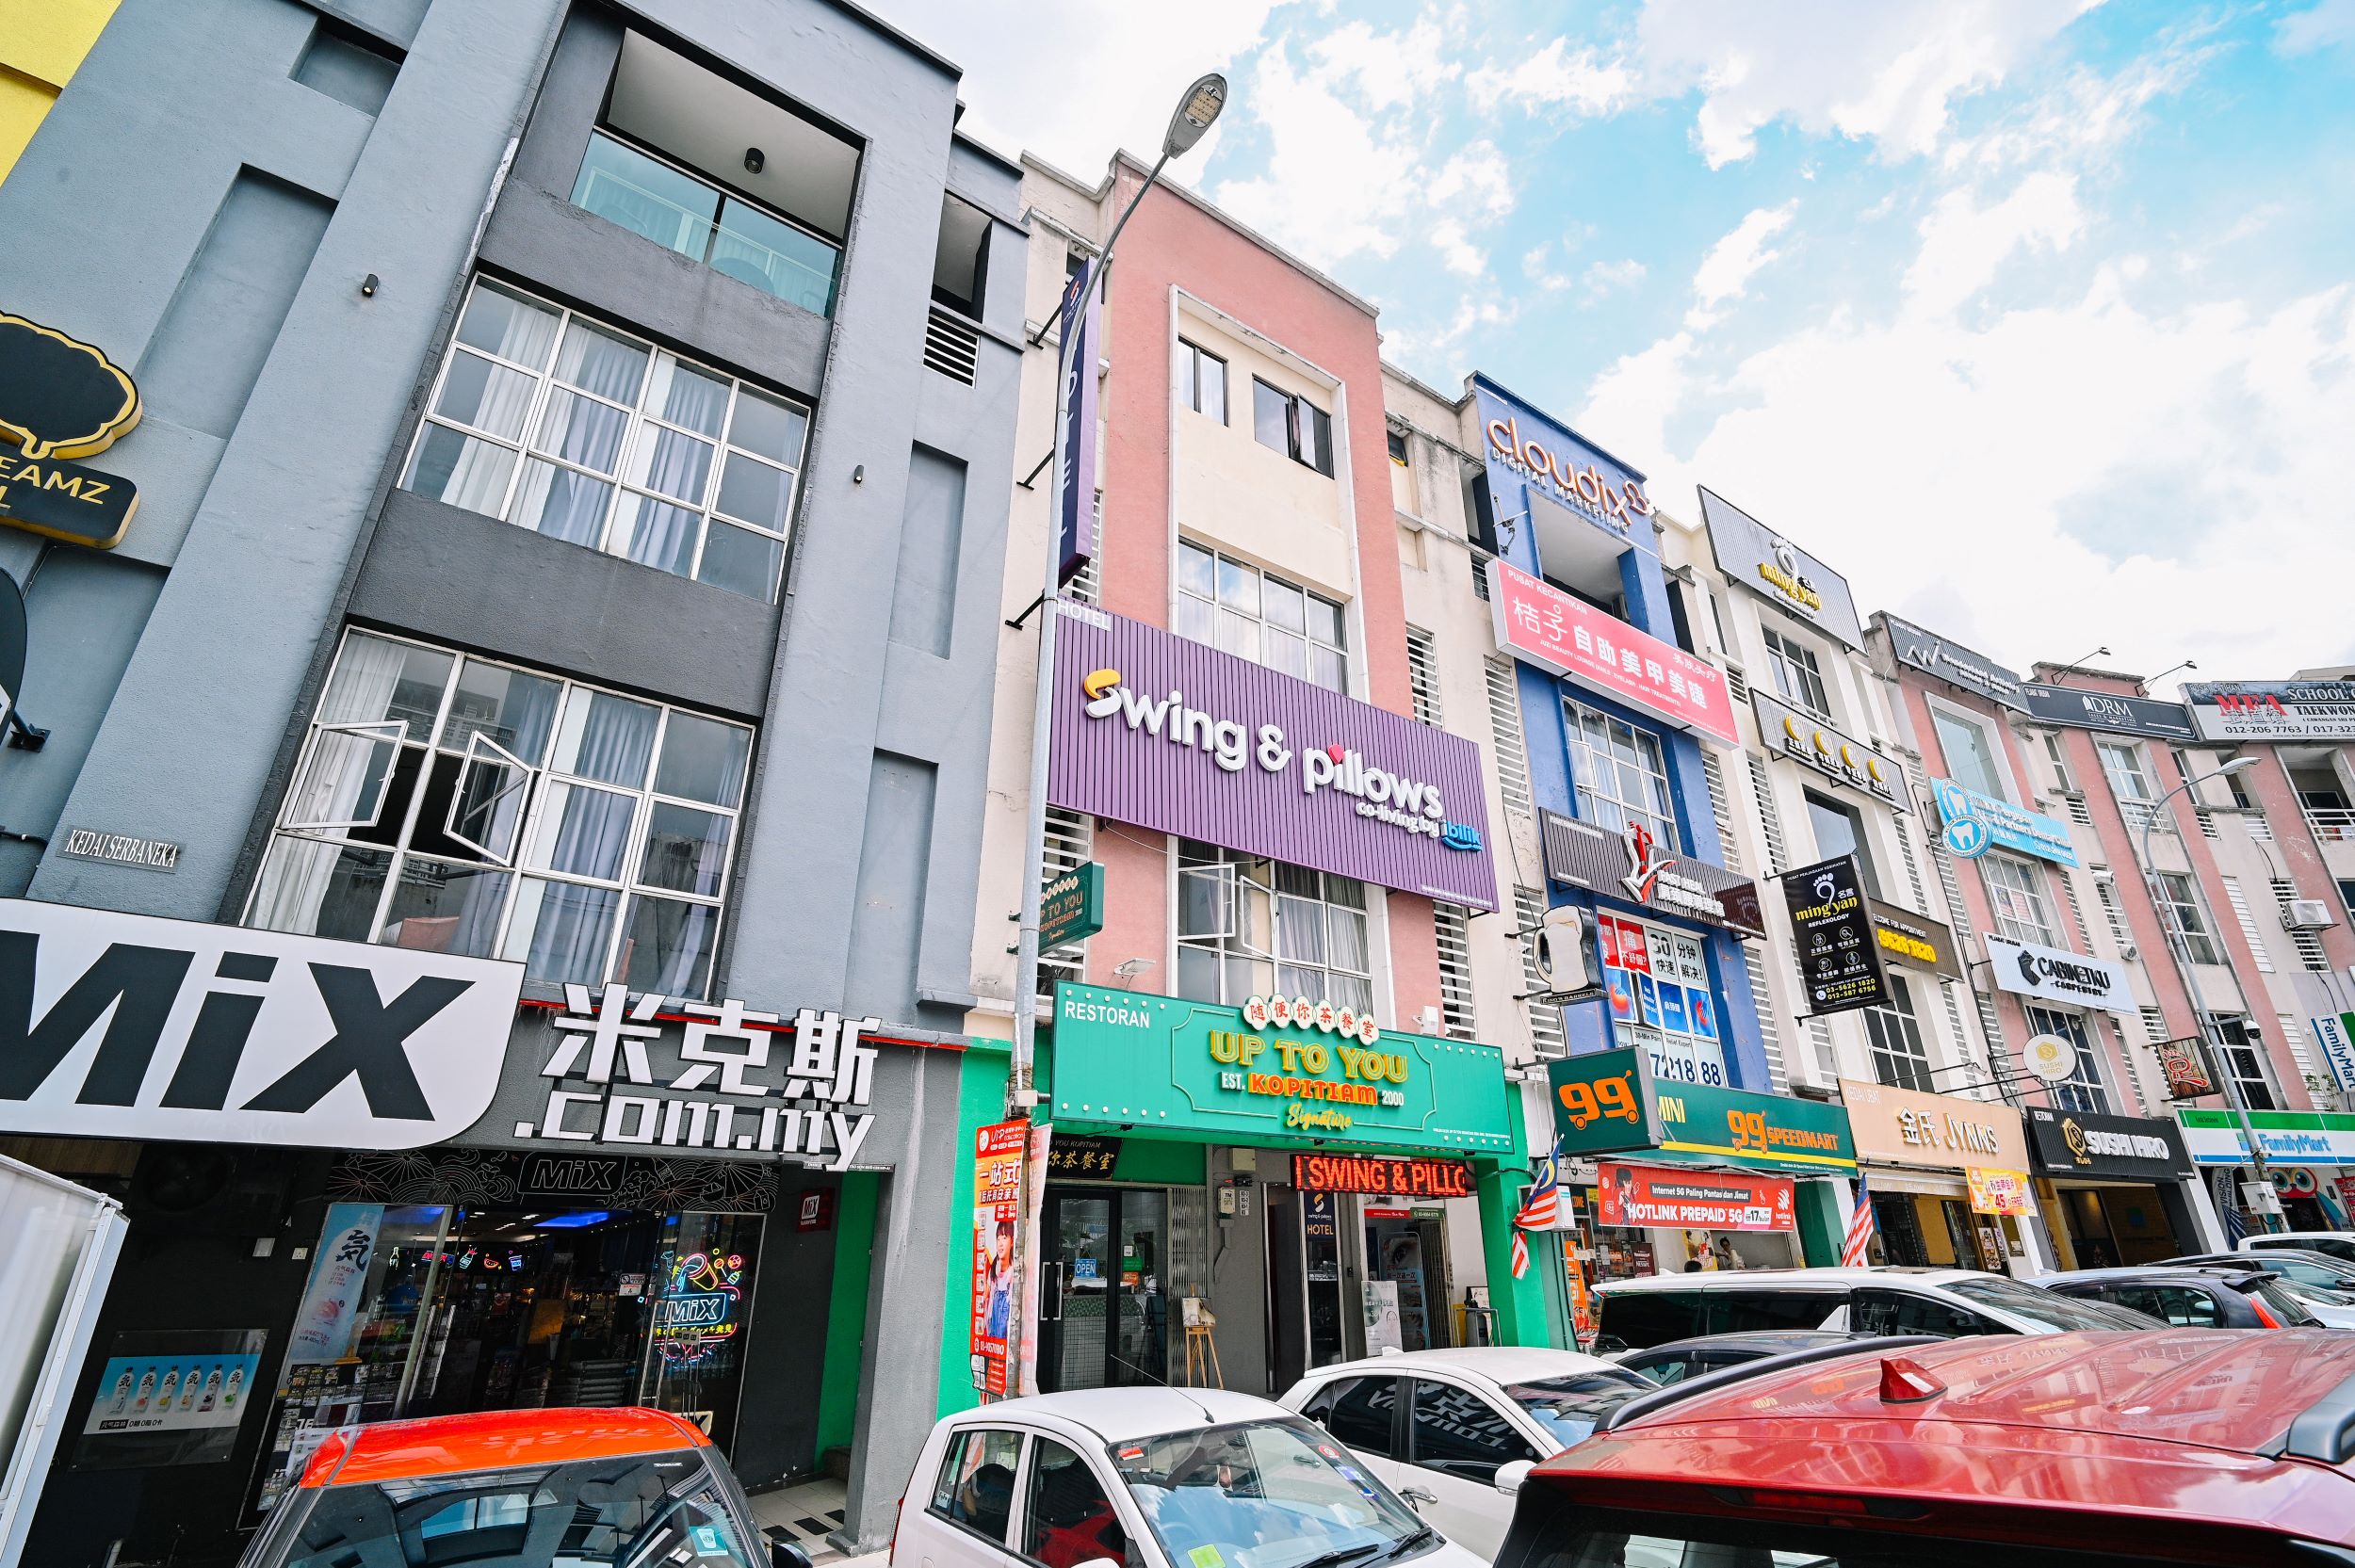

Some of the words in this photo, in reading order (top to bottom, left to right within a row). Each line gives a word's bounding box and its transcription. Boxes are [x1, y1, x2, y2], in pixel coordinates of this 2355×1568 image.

[1491, 445, 1550, 489] DIGITAL
[1554, 485, 1629, 533] MARKETING
[1507, 570, 1535, 590] PUSAT
[1535, 579, 1588, 616] KECANTIKAN
[1057, 602, 1111, 632] HOTEL
[1551, 643, 1574, 660] BEAUTY
[2091, 697, 2134, 718] DRM
[2287, 688, 2348, 701] SCHOOL
[1084, 668, 1248, 772] Swing
[1257, 723, 1293, 773] &
[1302, 743, 1445, 819] pillows
[2273, 725, 2302, 734] 7763
[1355, 800, 1420, 834] co-living
[1418, 816, 1440, 838] by
[63, 829, 107, 859] KEDAI
[105, 833, 180, 869] SERBANEKA
[1048, 903, 1061, 919] TO
[1064, 890, 1083, 912] YOU
[1795, 902, 1831, 921] ming
[1830, 897, 1858, 915] yan
[1808, 913, 1849, 928] REFLEXOLOGY
[1649, 933, 1671, 958] 30
[1677, 942, 1697, 962] 分钟
[1656, 960, 1676, 977] 快速
[1681, 962, 1703, 981] 解决!
[2037, 956, 2112, 990] CABINETKU
[1826, 981, 1857, 994] 03-5626
[1858, 978, 1876, 987] 1820
[1858, 985, 1876, 994] 6756
[0, 929, 478, 1123] MiX
[1064, 1000, 1150, 1029] RESTORAN
[1248, 1000, 1376, 1041] 随便你茶餐室
[541, 981, 883, 1107] 米克斯
[1210, 1028, 1267, 1068] UP
[1275, 1037, 1332, 1074] TO
[1336, 1044, 1410, 1084] YOU
[2038, 1060, 2063, 1069] SUSHI
[1220, 1070, 1246, 1091] EST.
[1247, 1072, 1378, 1107] KOPITIAM
[1381, 1090, 1405, 1107] 2000
[1558, 1068, 1641, 1132] 99
[1844, 1086, 1866, 1101] KEDAI
[1865, 1089, 1881, 1105] UBAT
[513, 1090, 877, 1172] .com.my
[1283, 1101, 1353, 1132] Signature
[1896, 1106, 1941, 1147] 金氏
[1943, 1112, 2000, 1155] JYNNS
[1055, 1140, 1069, 1148] YOU
[1070, 1140, 1101, 1149] KOPITIAM
[1726, 1108, 1769, 1155] 99
[1764, 1123, 1840, 1152] SPEEDMART
[2084, 1130, 2135, 1157] SUSHI
[2130, 1135, 2169, 1160] HIRO
[2258, 1133, 2332, 1154] FamilyMart
[530, 1158, 617, 1191] MiX
[979, 1158, 1021, 1187] 一站式
[1308, 1157, 1387, 1191] SWING
[1392, 1163, 1408, 1191] &
[1651, 1185, 1676, 1196] Internet
[1676, 1188, 1684, 1197] 5G
[1685, 1188, 1703, 1200] Paling
[1703, 1190, 1723, 1199] Pantas
[1733, 1192, 1749, 1201] Jimat
[1995, 1192, 2006, 1213] 45
[2216, 1176, 2228, 1205] VISION
[1628, 1203, 1679, 1222] HOTLINK
[1680, 1205, 1727, 1223] PREPAID
[1728, 1208, 1744, 1224] 5G
[1775, 1212, 1792, 1220] hotlink
[1307, 1224, 1334, 1236] HOTEL
[1076, 1263, 1096, 1275] OPEN
[665, 1299, 720, 1322] MiX
